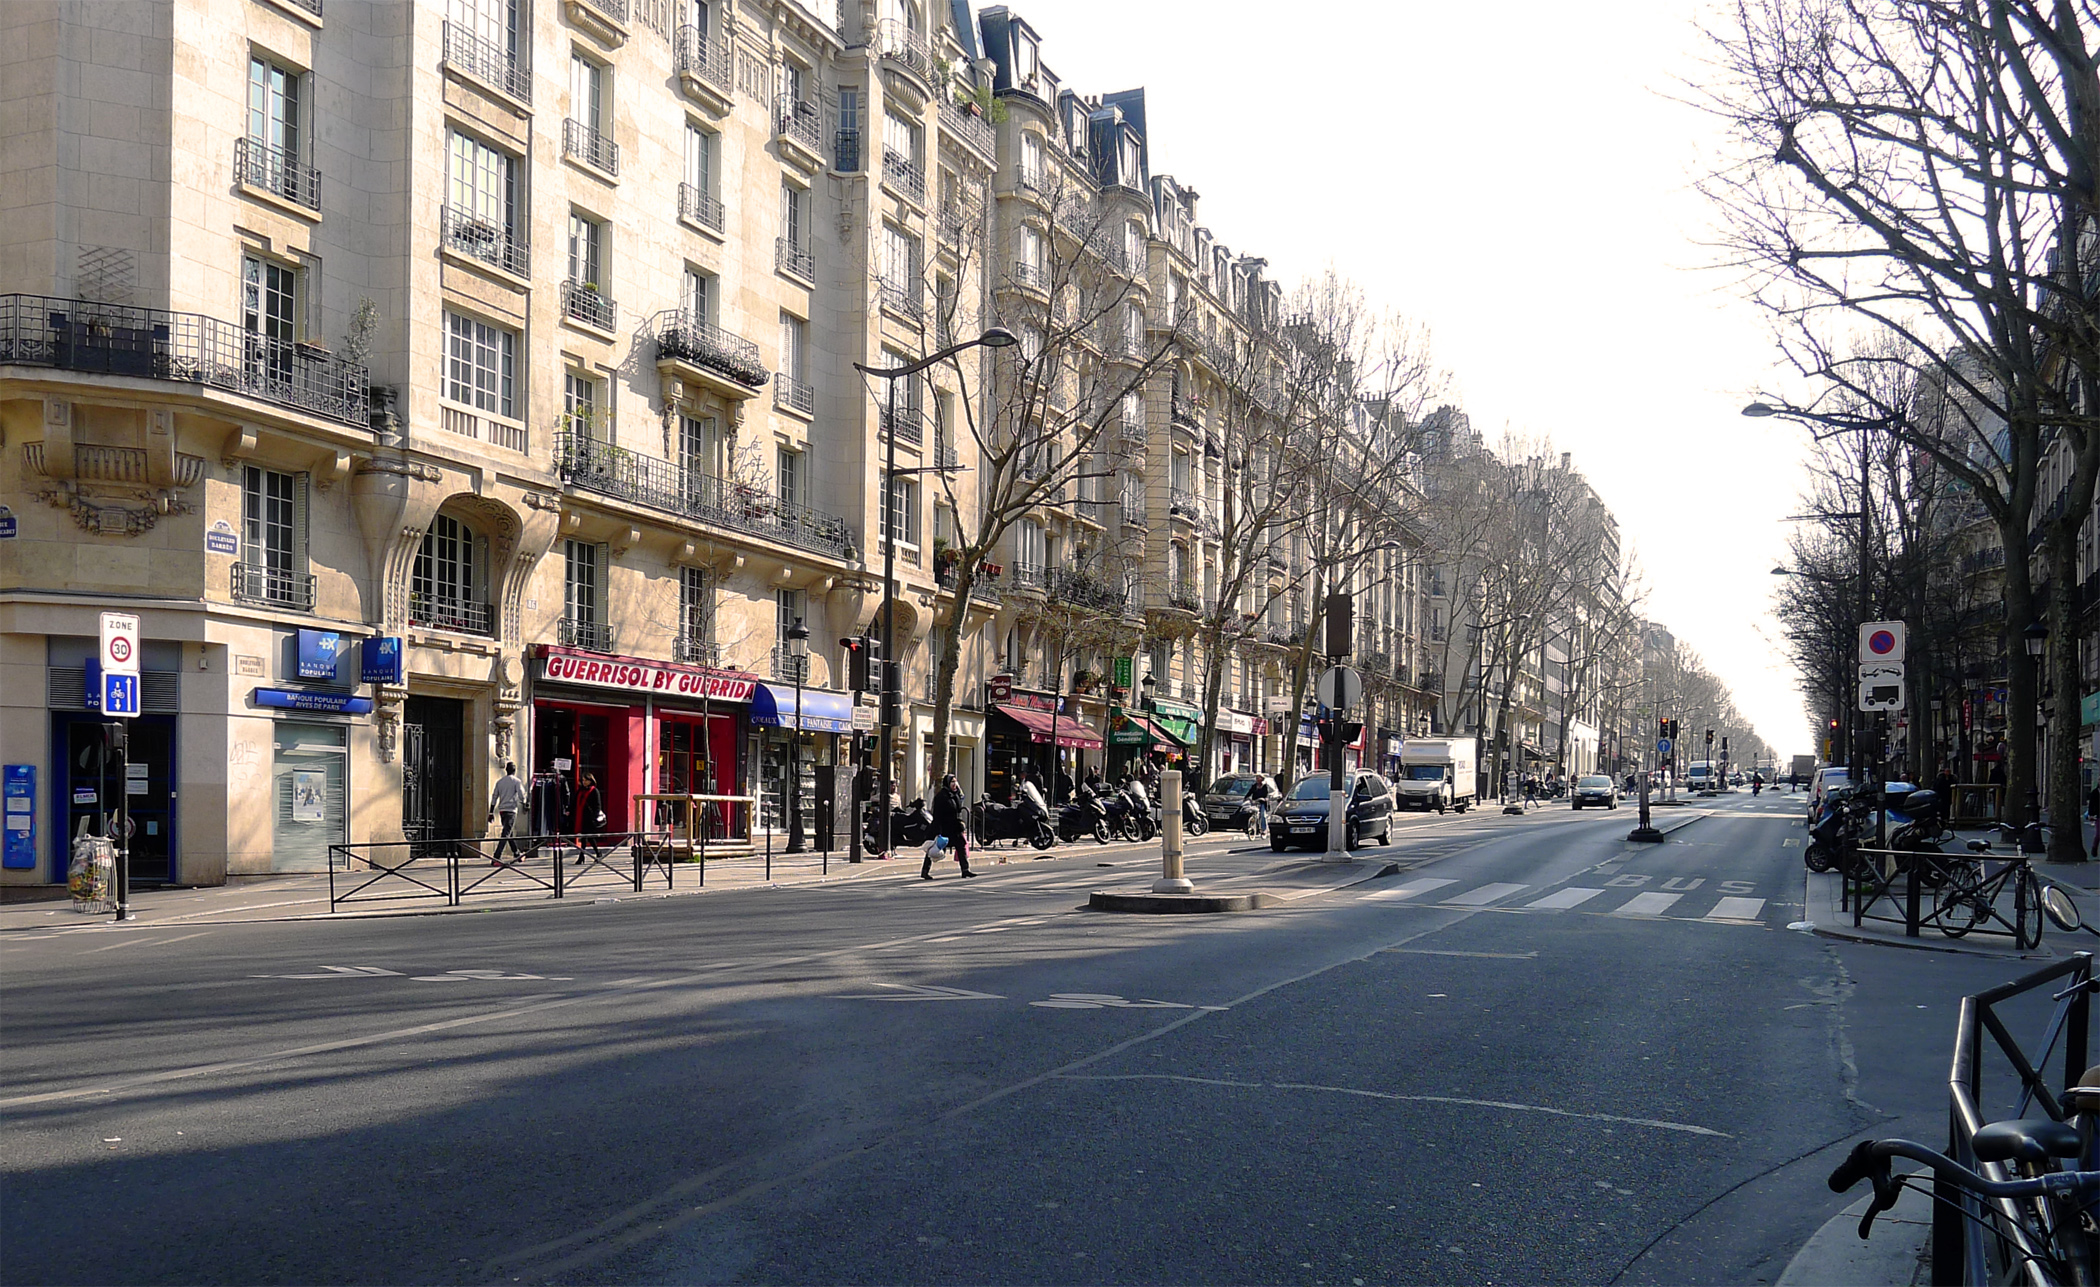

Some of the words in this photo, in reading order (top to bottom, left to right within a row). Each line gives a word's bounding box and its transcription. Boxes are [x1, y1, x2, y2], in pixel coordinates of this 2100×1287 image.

[109, 621, 132, 630] ZONE
[114, 644, 127, 655] 30
[301, 662, 335, 670] BANQUE
[301, 669, 335, 677] POPULAIRE
[548, 657, 649, 688] GUERRISOL
[653, 671, 676, 690] BY
[678, 674, 755, 700] GUERRIDA
[287, 693, 313, 703] BANQUE
[314, 696, 347, 705] POPULAIRE
[322, 703, 340, 711] PARIS
[1603, 874, 1757, 894] BUS
